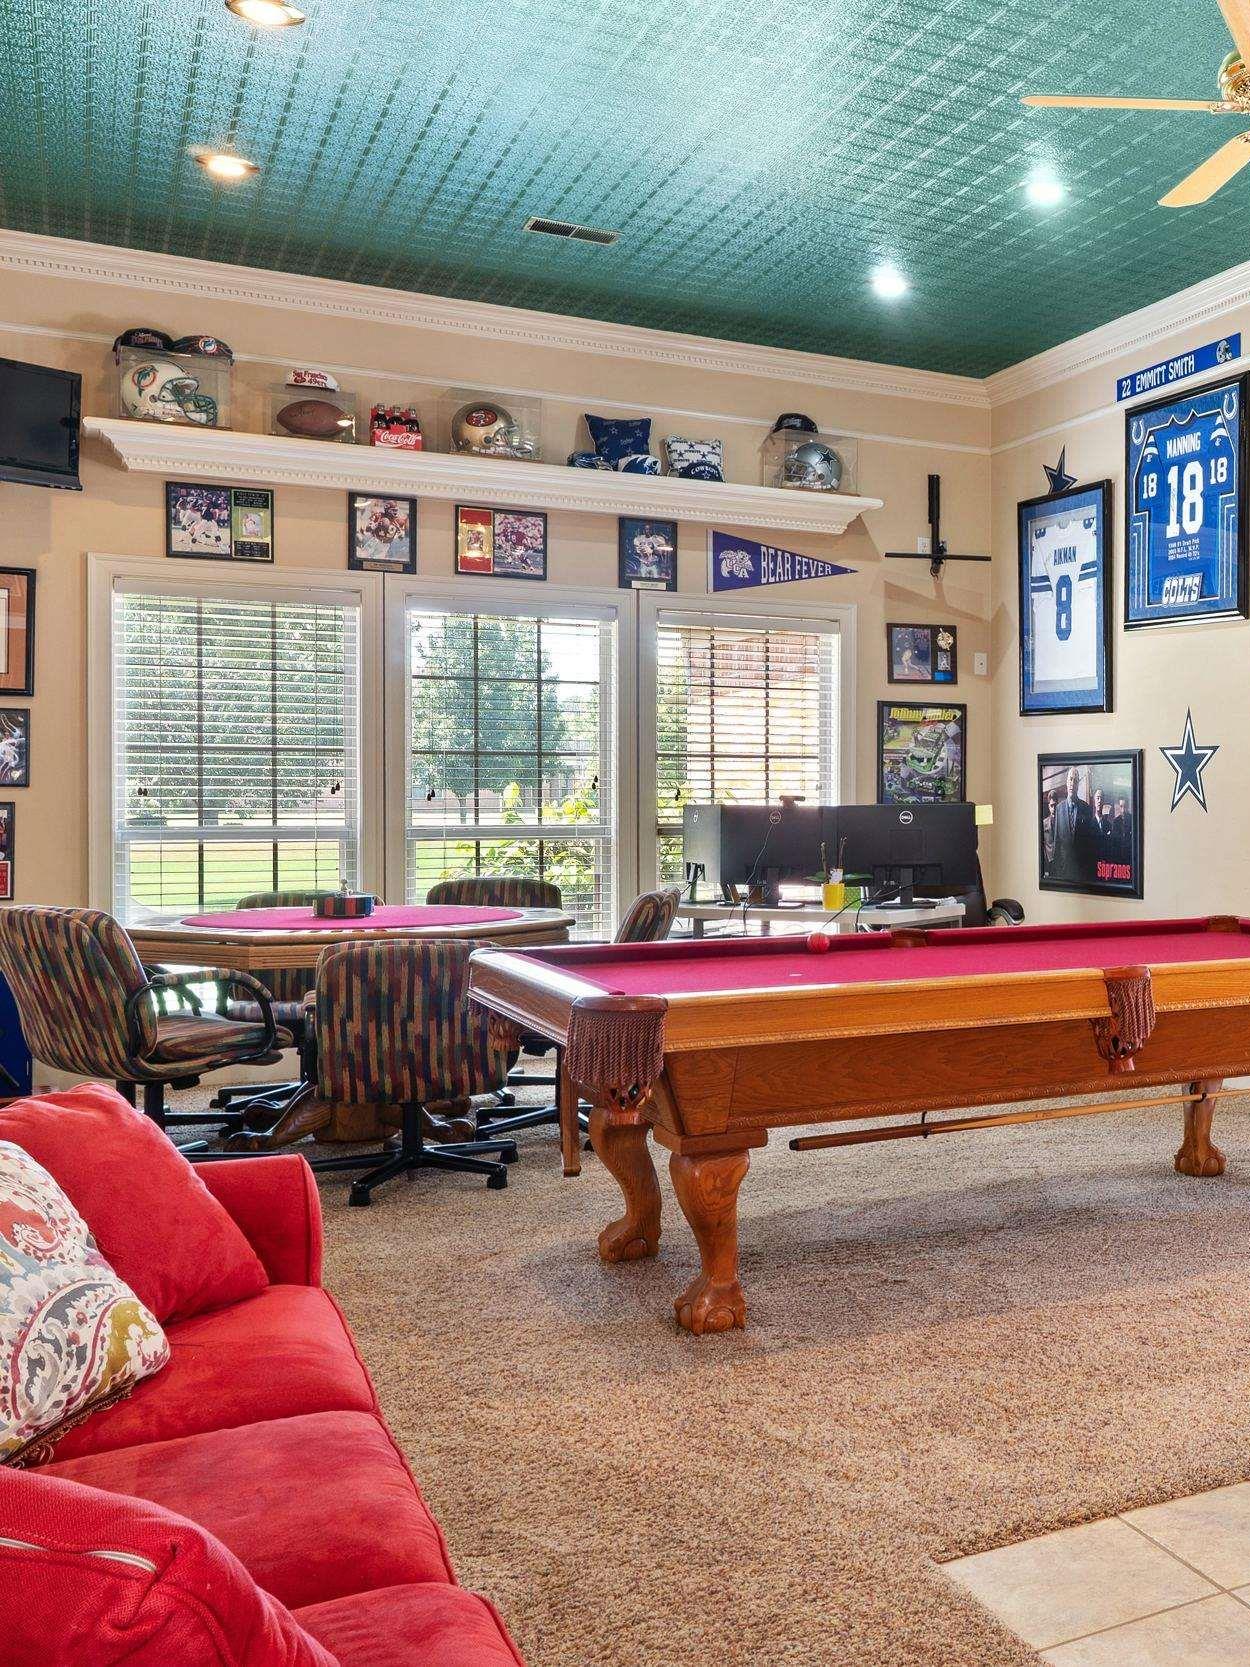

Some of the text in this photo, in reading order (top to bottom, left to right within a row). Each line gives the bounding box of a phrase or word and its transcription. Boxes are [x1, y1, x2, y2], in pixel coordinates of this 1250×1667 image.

[1121, 354, 1195, 398] 22 EMMITT SMITH
[1166, 431, 1202, 459] MANNING
[1209, 456, 1228, 485] 18
[1143, 472, 1158, 499] 18
[1166, 460, 1204, 539] 18
[760, 545, 832, 584] BEAR FEVER
[1053, 546, 1077, 566] AIKMAN
[1162, 576, 1200, 606] COLTS
[1056, 574, 1073, 641] 8
[1097, 860, 1131, 881] Sopranos
